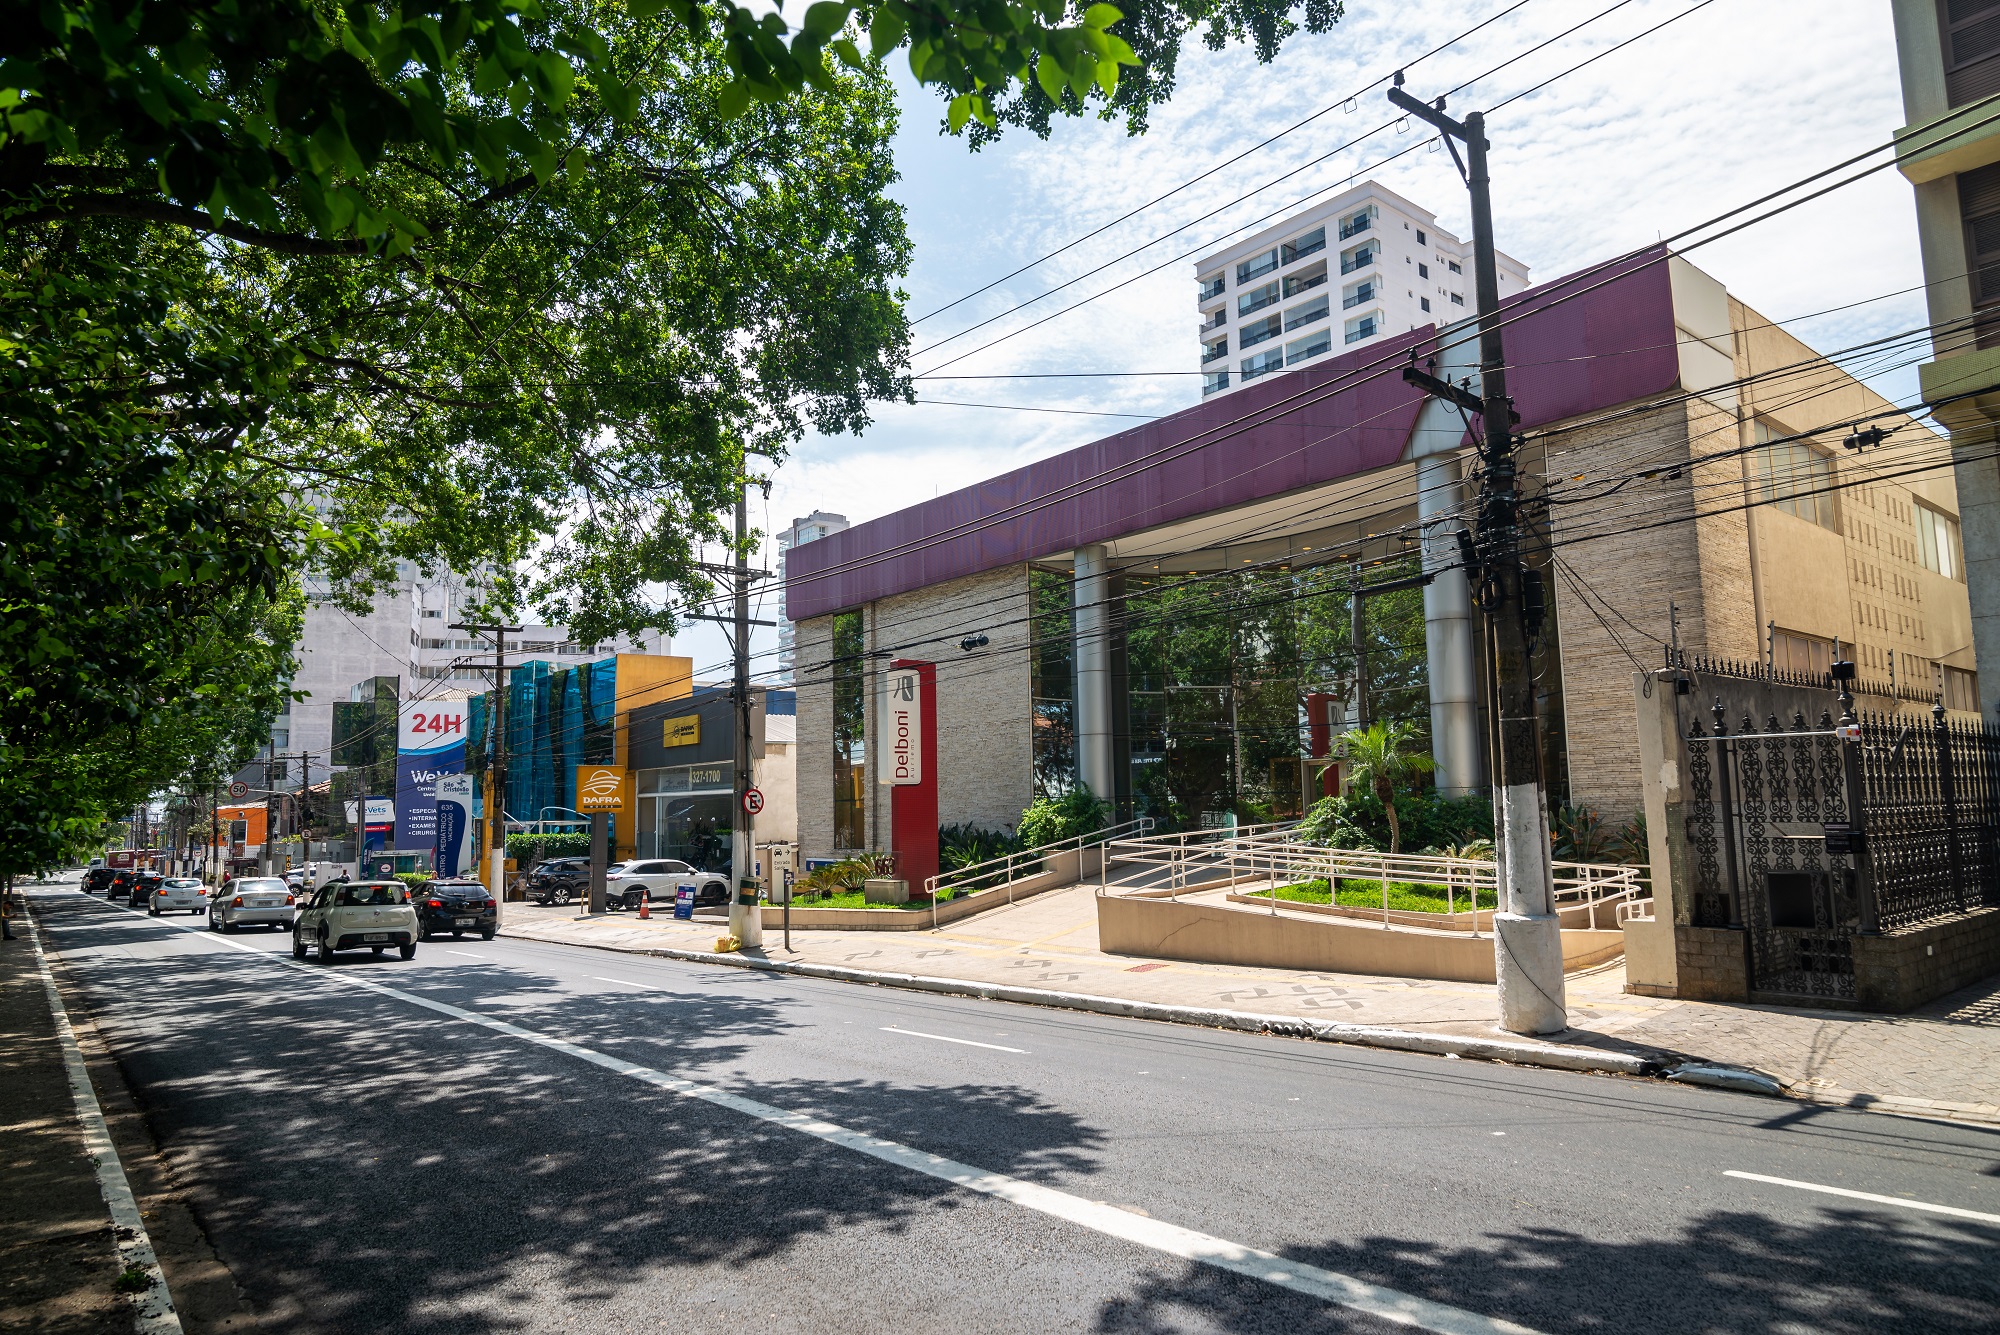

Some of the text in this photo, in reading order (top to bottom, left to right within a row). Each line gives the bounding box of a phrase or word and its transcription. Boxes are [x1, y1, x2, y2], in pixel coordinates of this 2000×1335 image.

[411, 713, 461, 733] 24H
[894, 710, 909, 778] Delboni
[232, 785, 246, 793] 50
[875, 858, 895, 876] 663
